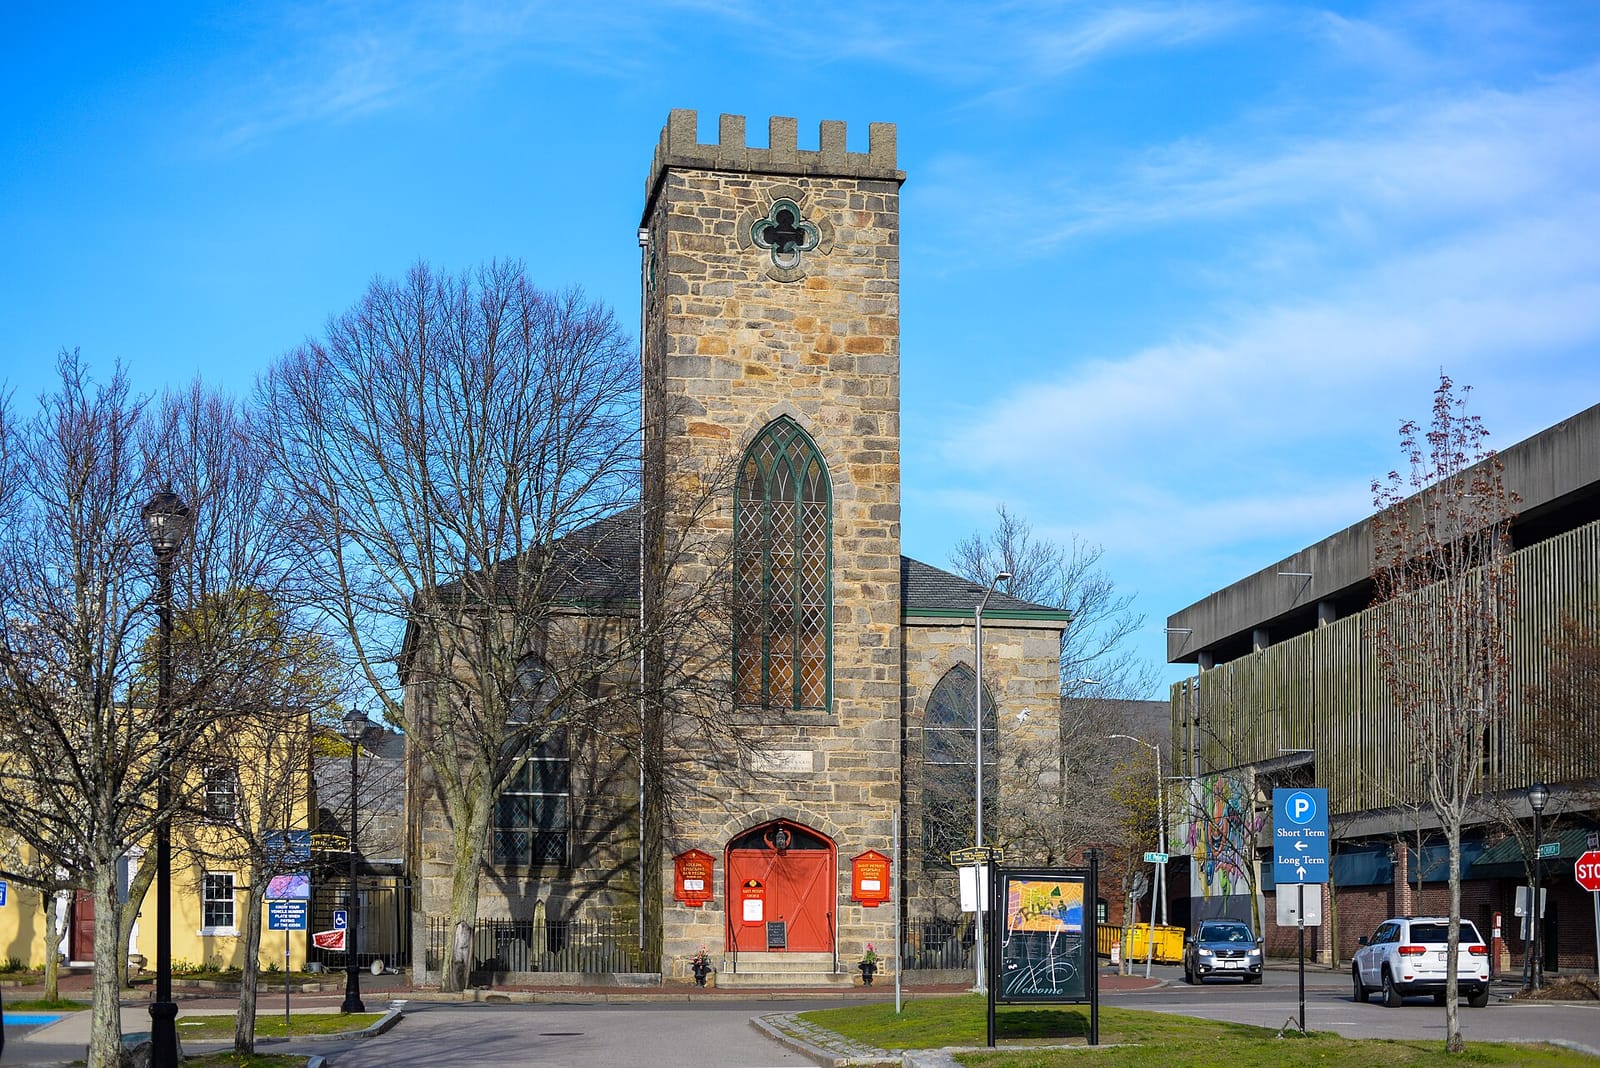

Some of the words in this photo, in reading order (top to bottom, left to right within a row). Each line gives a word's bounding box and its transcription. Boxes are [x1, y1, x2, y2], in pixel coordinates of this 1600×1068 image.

[1295, 798, 1309, 818] P
[1277, 828, 1300, 837] Short
[1302, 828, 1325, 837] Term
[1278, 855, 1300, 866] Long
[1302, 855, 1325, 864] Term
[1578, 864, 1600, 879] STO
[1005, 964, 1065, 995] Welcome
